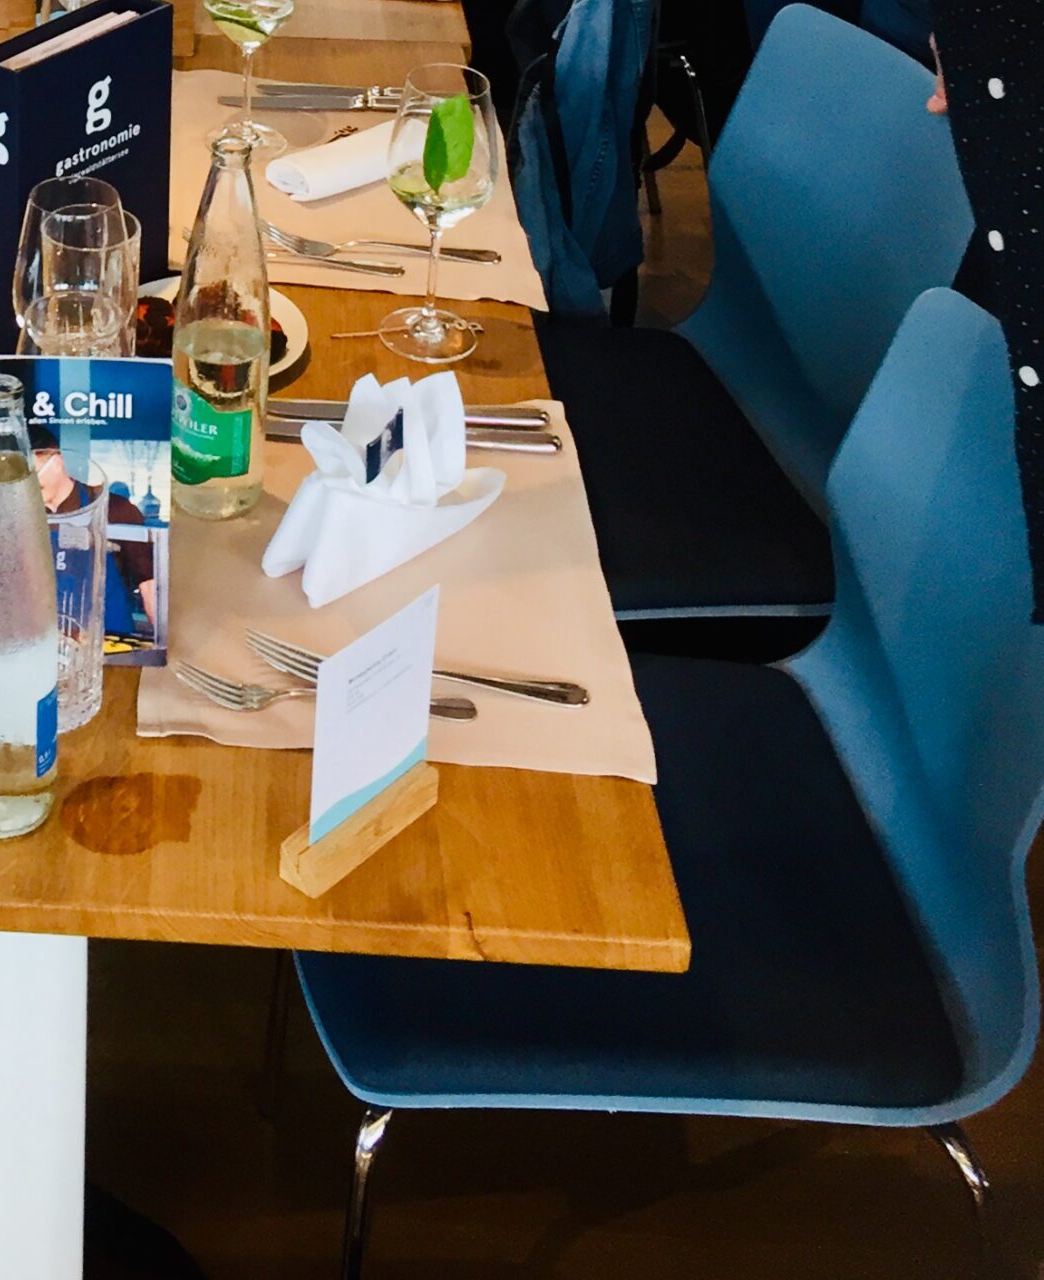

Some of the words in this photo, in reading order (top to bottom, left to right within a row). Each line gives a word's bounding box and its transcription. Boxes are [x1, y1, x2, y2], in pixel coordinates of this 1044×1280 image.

[86, 75, 112, 135] g
[56, 123, 141, 178] gastronomie
[32, 391, 55, 417] &
[64, 391, 133, 419] Chill
